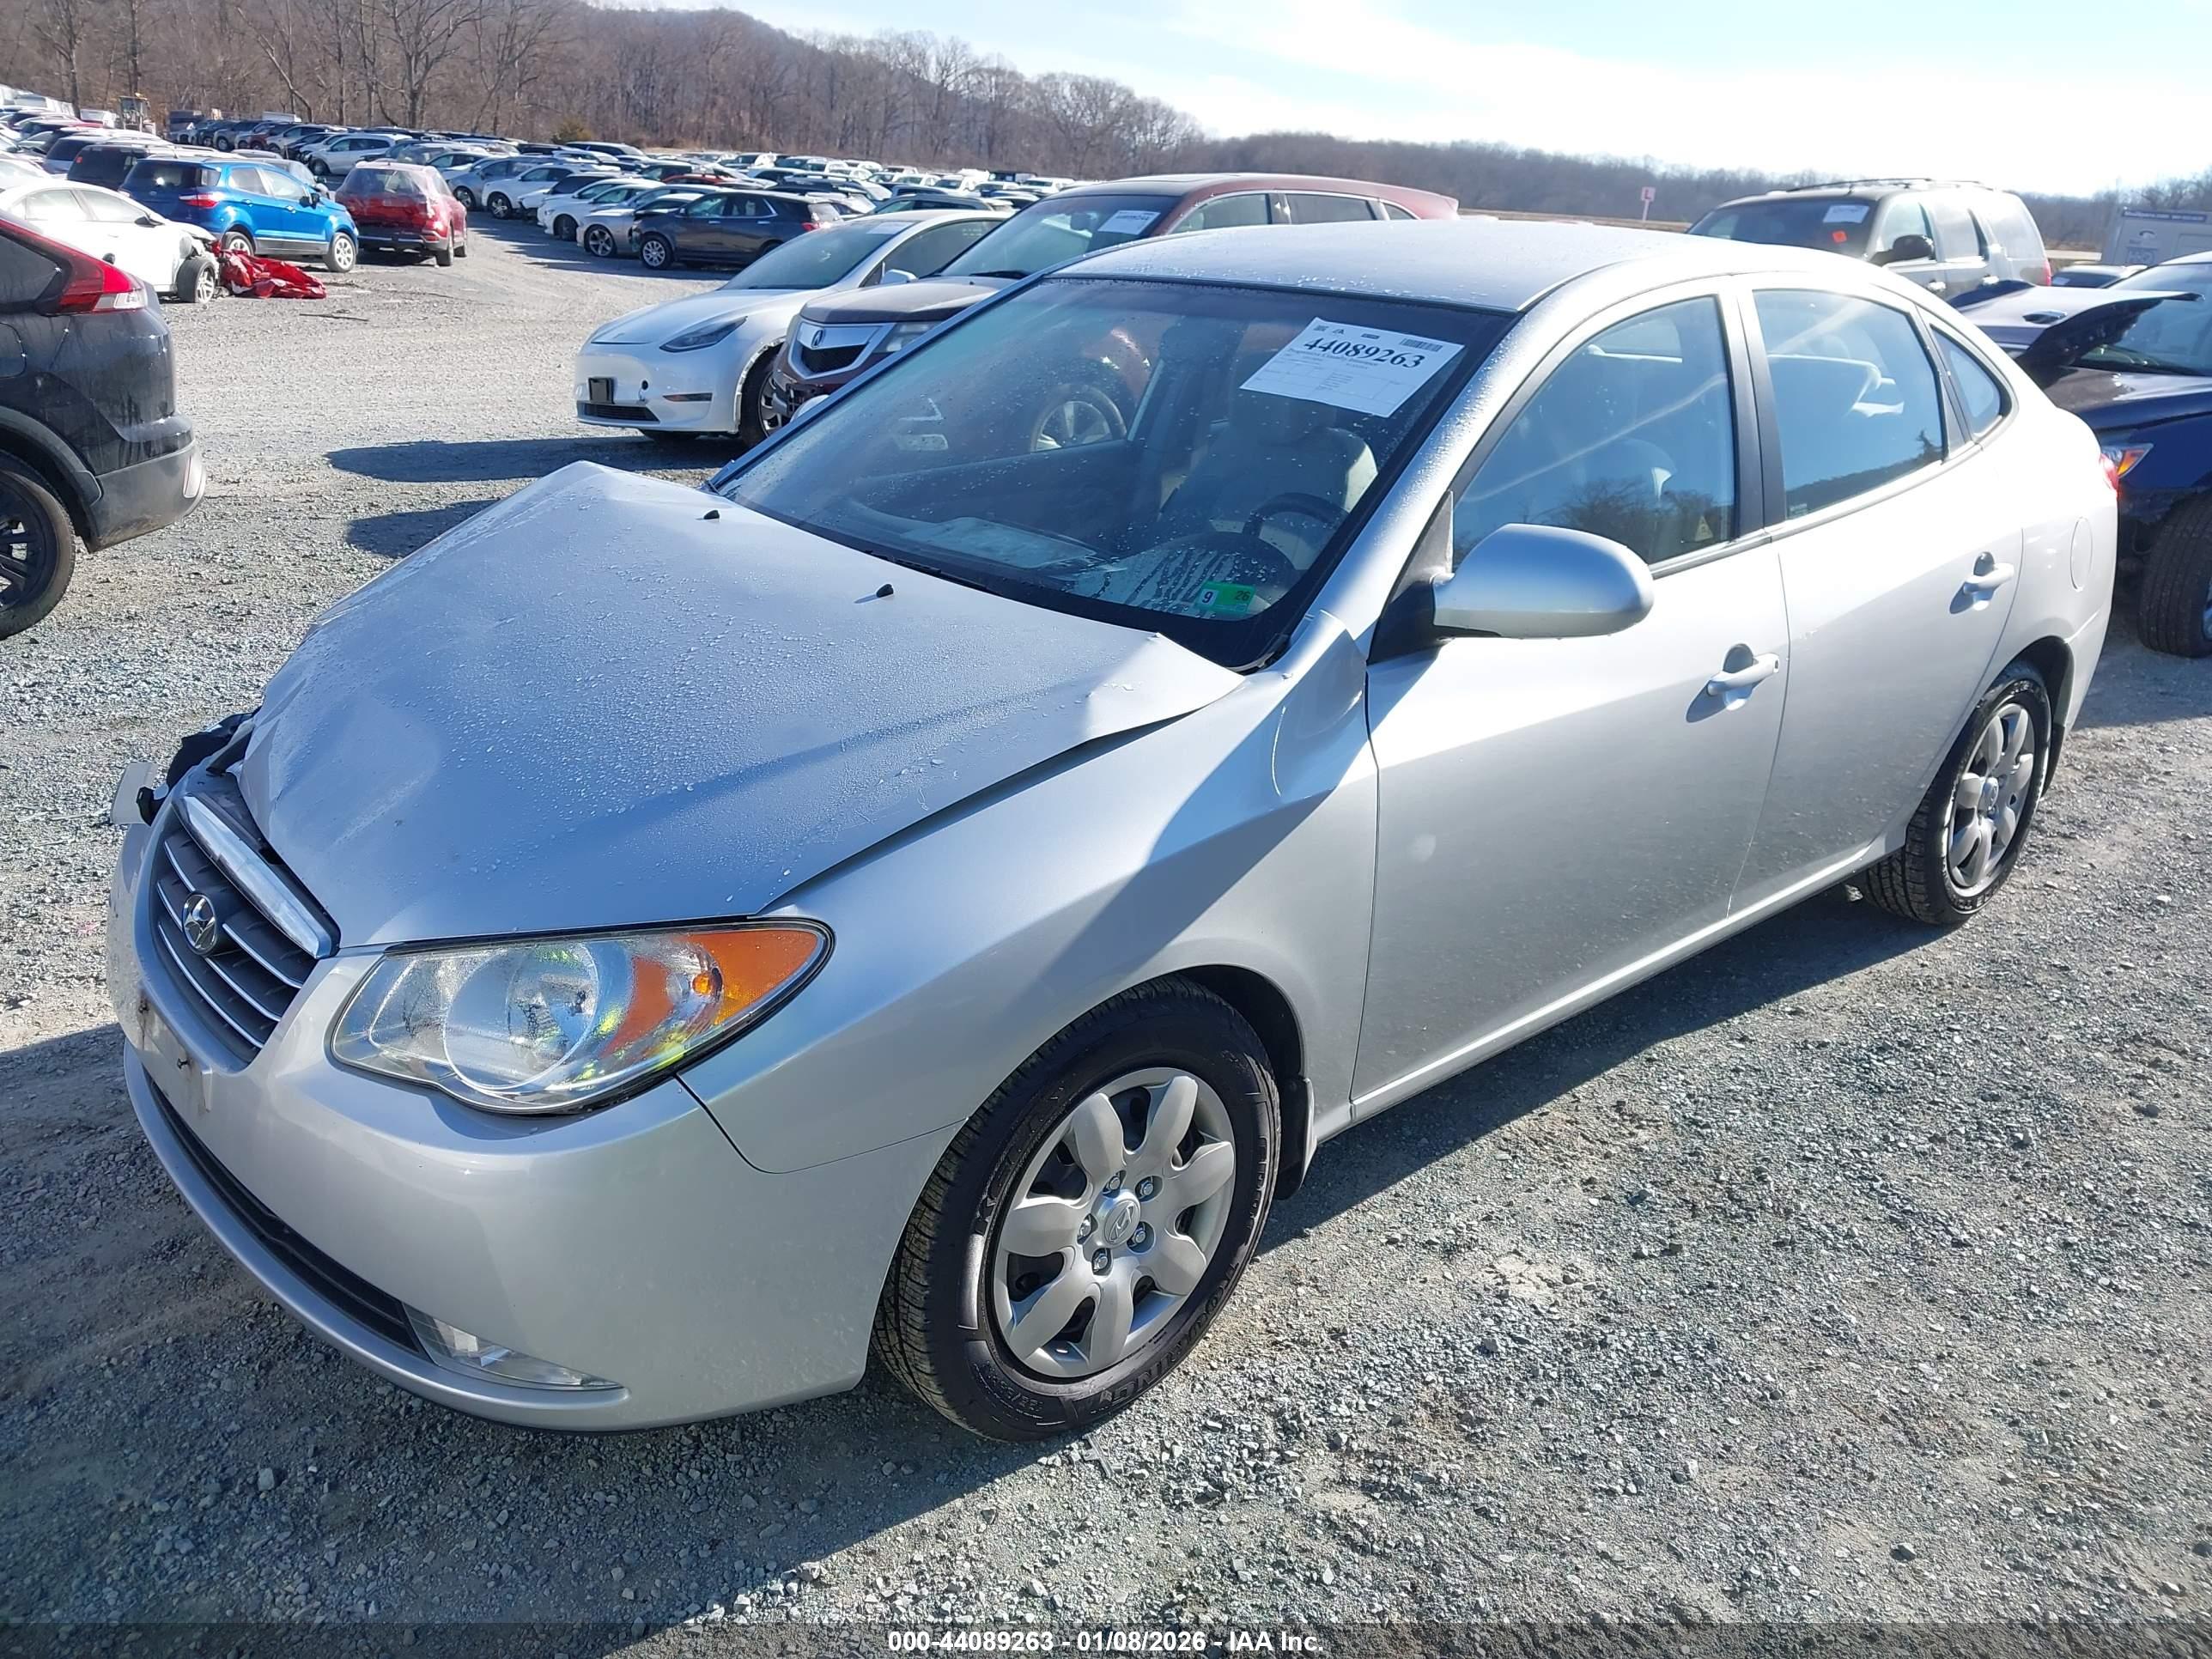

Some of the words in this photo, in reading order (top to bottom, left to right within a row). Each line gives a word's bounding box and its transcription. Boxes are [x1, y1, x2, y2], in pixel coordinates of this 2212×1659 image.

[1304, 337, 1425, 368] 44089263
[1202, 591, 1213, 604] 9
[1234, 590, 1251, 601] 26
